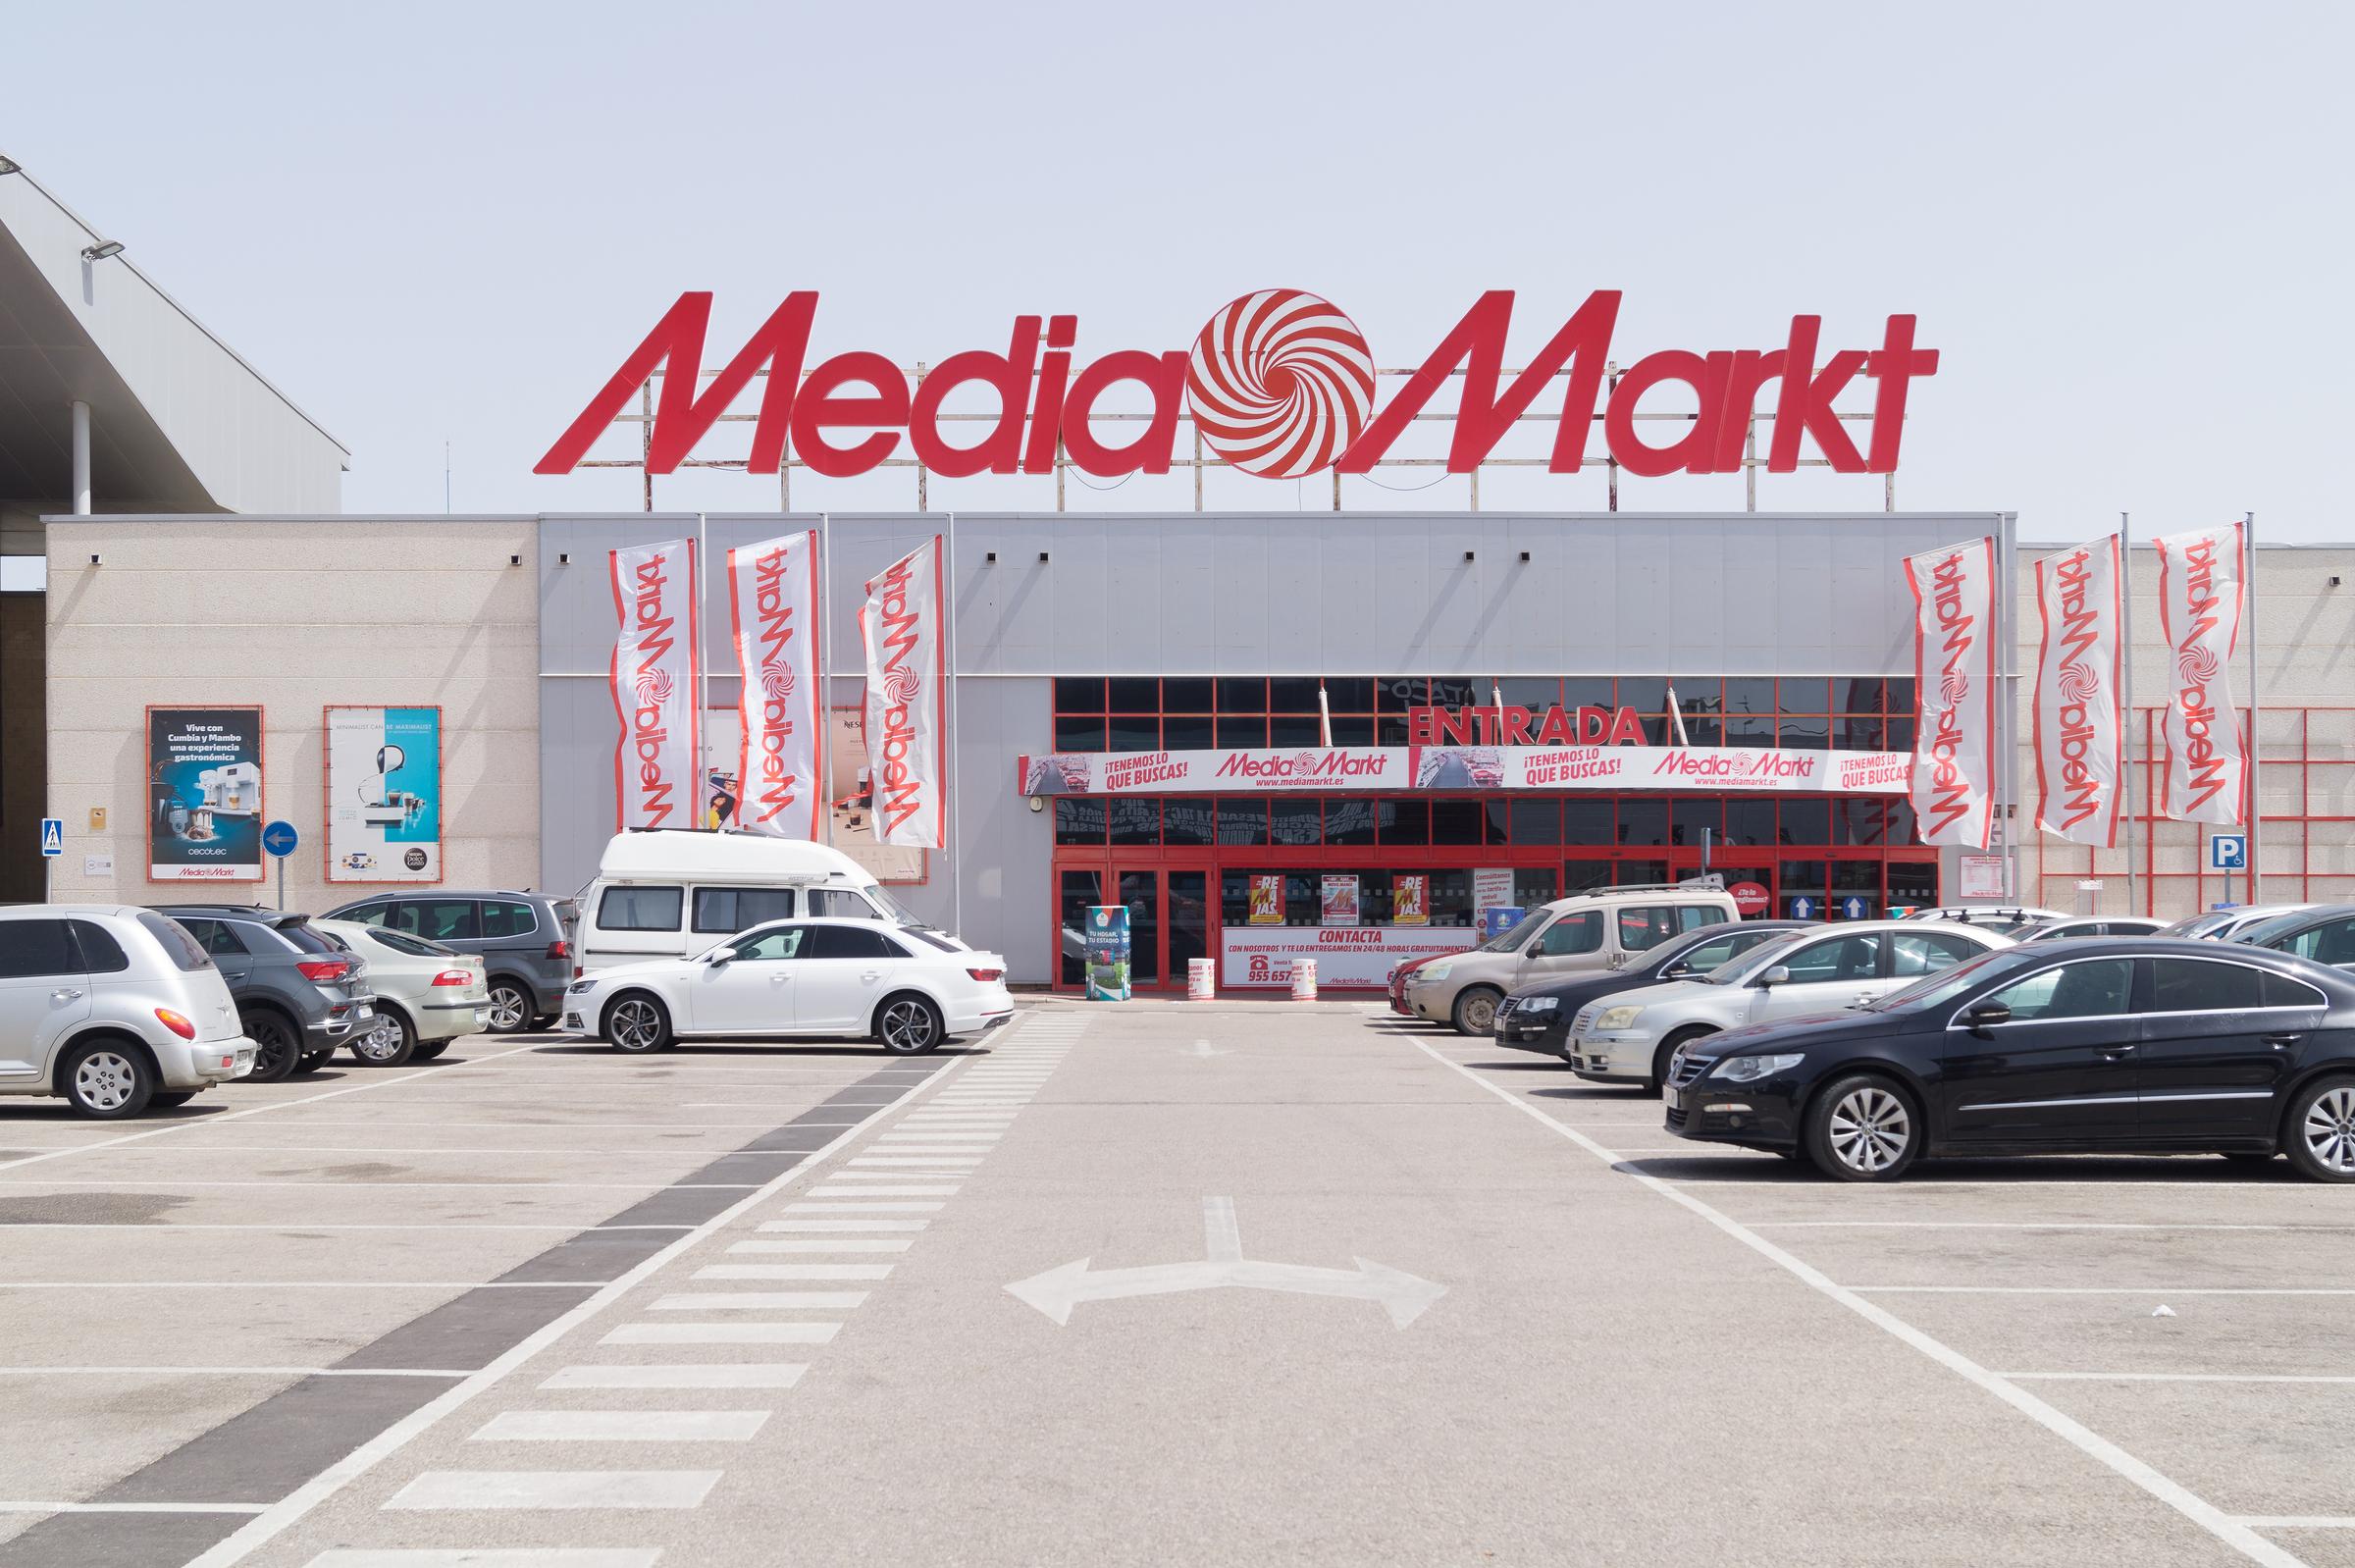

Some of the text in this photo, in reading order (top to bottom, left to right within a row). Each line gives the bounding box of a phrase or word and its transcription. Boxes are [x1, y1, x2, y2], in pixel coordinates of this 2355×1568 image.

[533, 290, 1939, 476] Media Markt
[1408, 706, 1648, 746] ENTRADA
[187, 744, 239, 754] experiencia
[201, 736, 207, 745] y
[175, 753, 236, 762] gastronómica
[1105, 752, 1169, 774] ¡TENEMOS LO
[1215, 751, 1387, 777] Media Markt
[1524, 748, 1599, 768] ¡TENEMOS LO
[1653, 751, 1814, 777] Media Markt
[1840, 754, 1897, 772] ¡TENEMOS LO
[1106, 761, 1188, 791] QUE BUSCAS!
[1526, 758, 1621, 787] QUE BUSCAS!
[1695, 777, 1777, 786] www.mediamarkt.es
[1842, 771, 1866, 789] QUE
[1256, 777, 1343, 787] www.mediamarkt.es
[2218, 839, 2239, 864] P
[179, 867, 205, 876] Media
[1319, 930, 1383, 943] CONTACTA
[1248, 971, 1292, 981] 955 657
